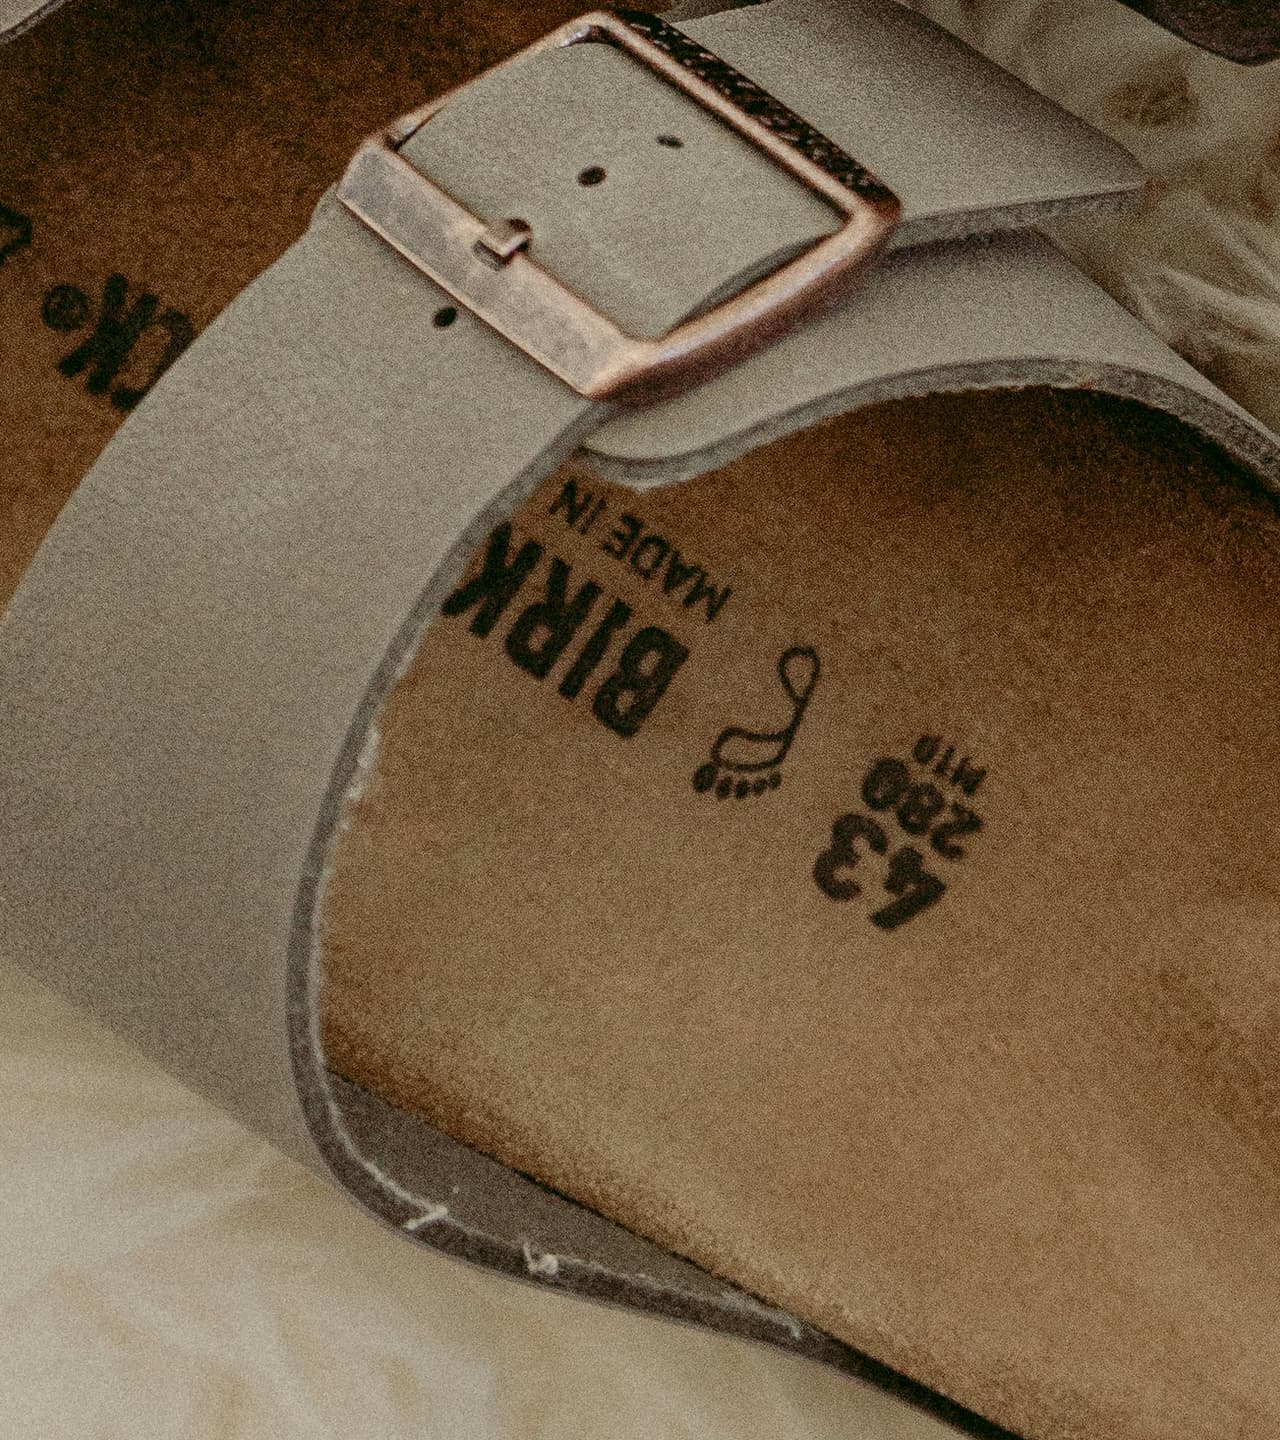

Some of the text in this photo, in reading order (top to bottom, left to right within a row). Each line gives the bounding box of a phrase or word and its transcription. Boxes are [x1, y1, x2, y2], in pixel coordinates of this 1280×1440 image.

[547, 478, 733, 623] MADE IN
[860, 757, 984, 859] 280
[813, 812, 946, 931] 43
